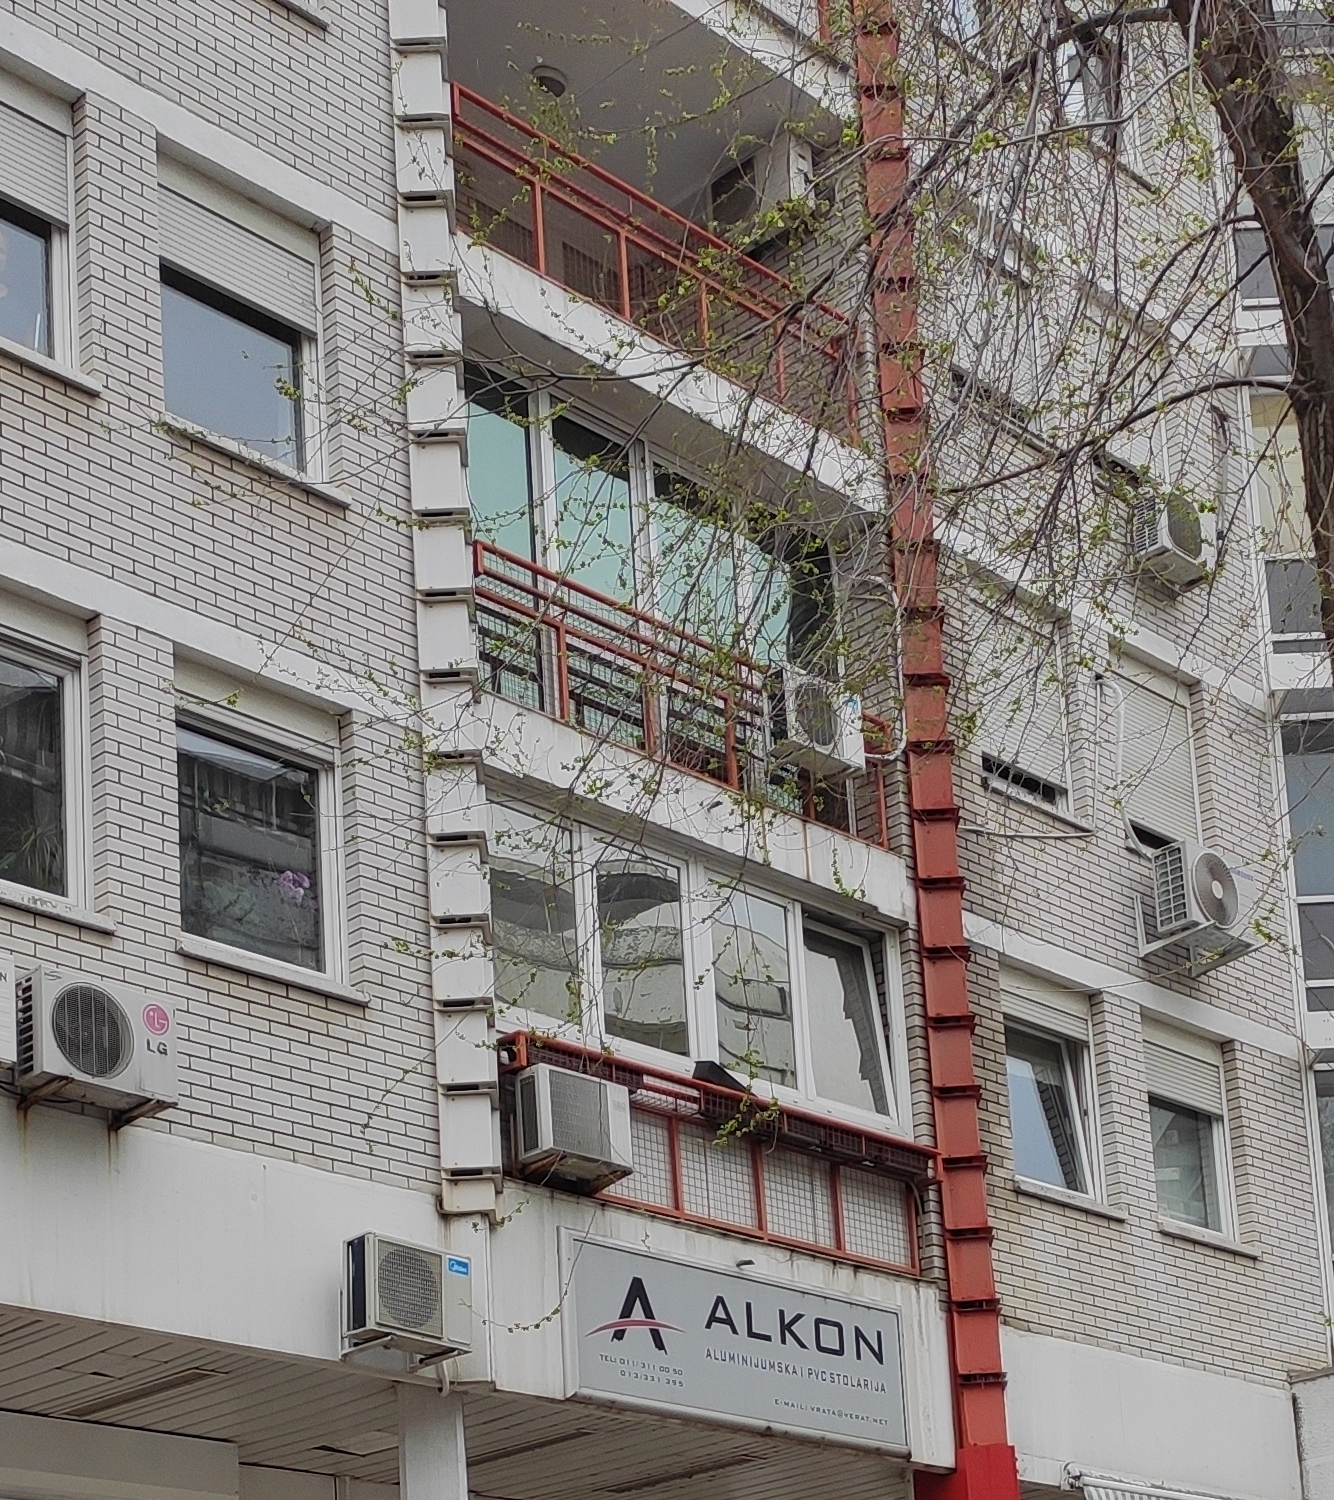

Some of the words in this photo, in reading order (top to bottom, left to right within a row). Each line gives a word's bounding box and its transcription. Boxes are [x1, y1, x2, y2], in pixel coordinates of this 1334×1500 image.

[146, 1038, 169, 1056] LG
[704, 1294, 884, 1366] ALKON
[599, 1353, 617, 1364] TEL:
[658, 1365, 670, 1374] 00
[705, 1347, 798, 1376] ALUMINIJUMSKA
[800, 1366, 804, 1378] I
[807, 1367, 827, 1382] PVC
[829, 1371, 887, 1394] STOLARIJA
[665, 1378, 684, 1387] 395
[774, 1398, 808, 1411] E-MAIL:
[810, 1405, 889, 1426] VRATA@VERAT.NET
